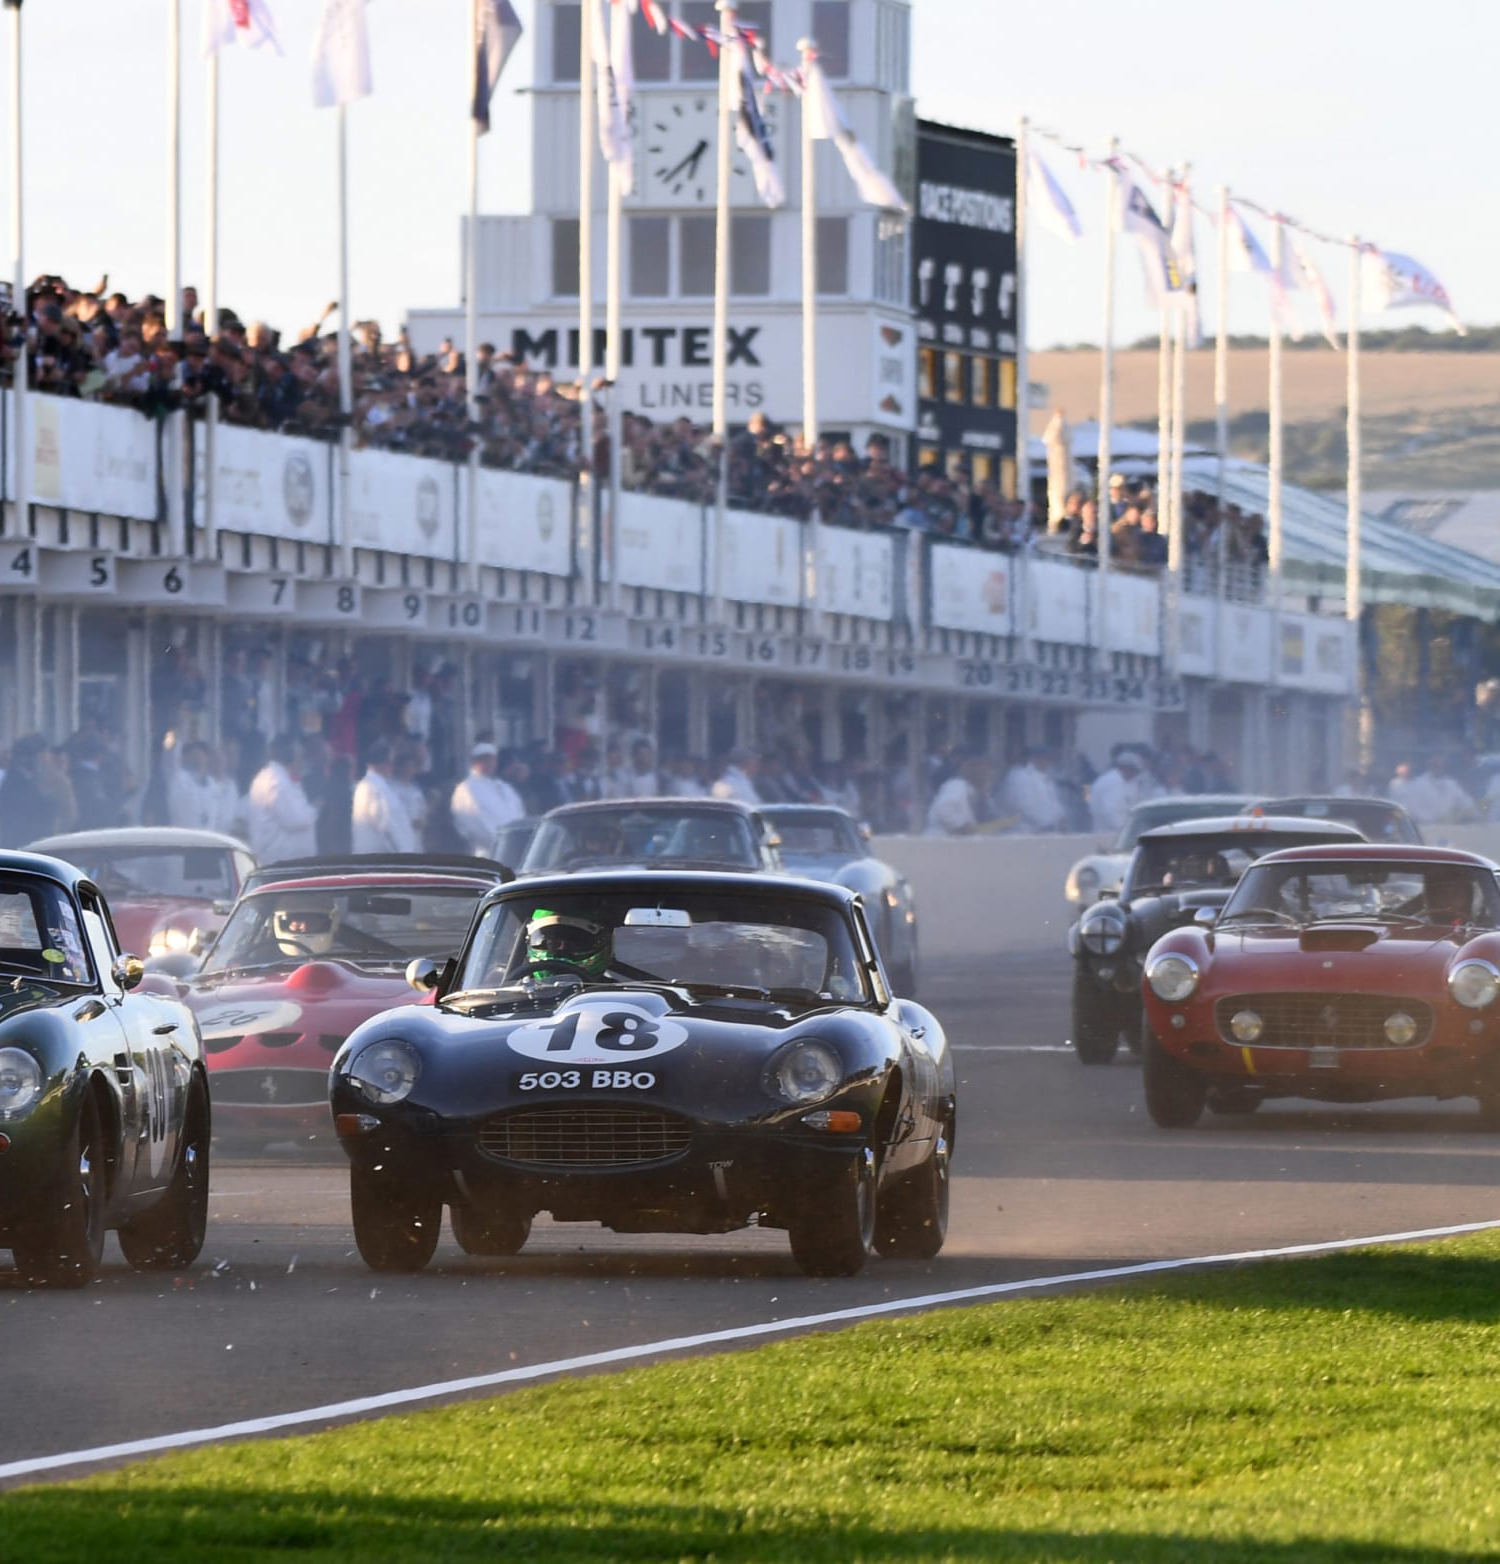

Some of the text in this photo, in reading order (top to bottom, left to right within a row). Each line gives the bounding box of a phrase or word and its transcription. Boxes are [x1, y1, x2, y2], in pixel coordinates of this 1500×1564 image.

[12, 549, 31, 576] 4
[91, 559, 107, 586] 5
[165, 566, 182, 593] 6
[271, 580, 288, 605] 7
[337, 587, 355, 613] 8
[404, 594, 420, 619] 9
[448, 602, 480, 627] 10
[514, 607, 541, 632] 11
[565, 616, 595, 641] 12
[645, 627, 673, 649] 14
[699, 632, 725, 655] 15
[746, 638, 775, 661] 16
[795, 643, 821, 665] 17
[842, 648, 870, 670] 18
[963, 665, 992, 686] 20
[1041, 674, 1070, 695] 22
[201, 1010, 270, 1026] 26
[539, 1012, 661, 1051] 18
[518, 1071, 656, 1091] 503 BBO
[707, 1159, 735, 1169] TOW
